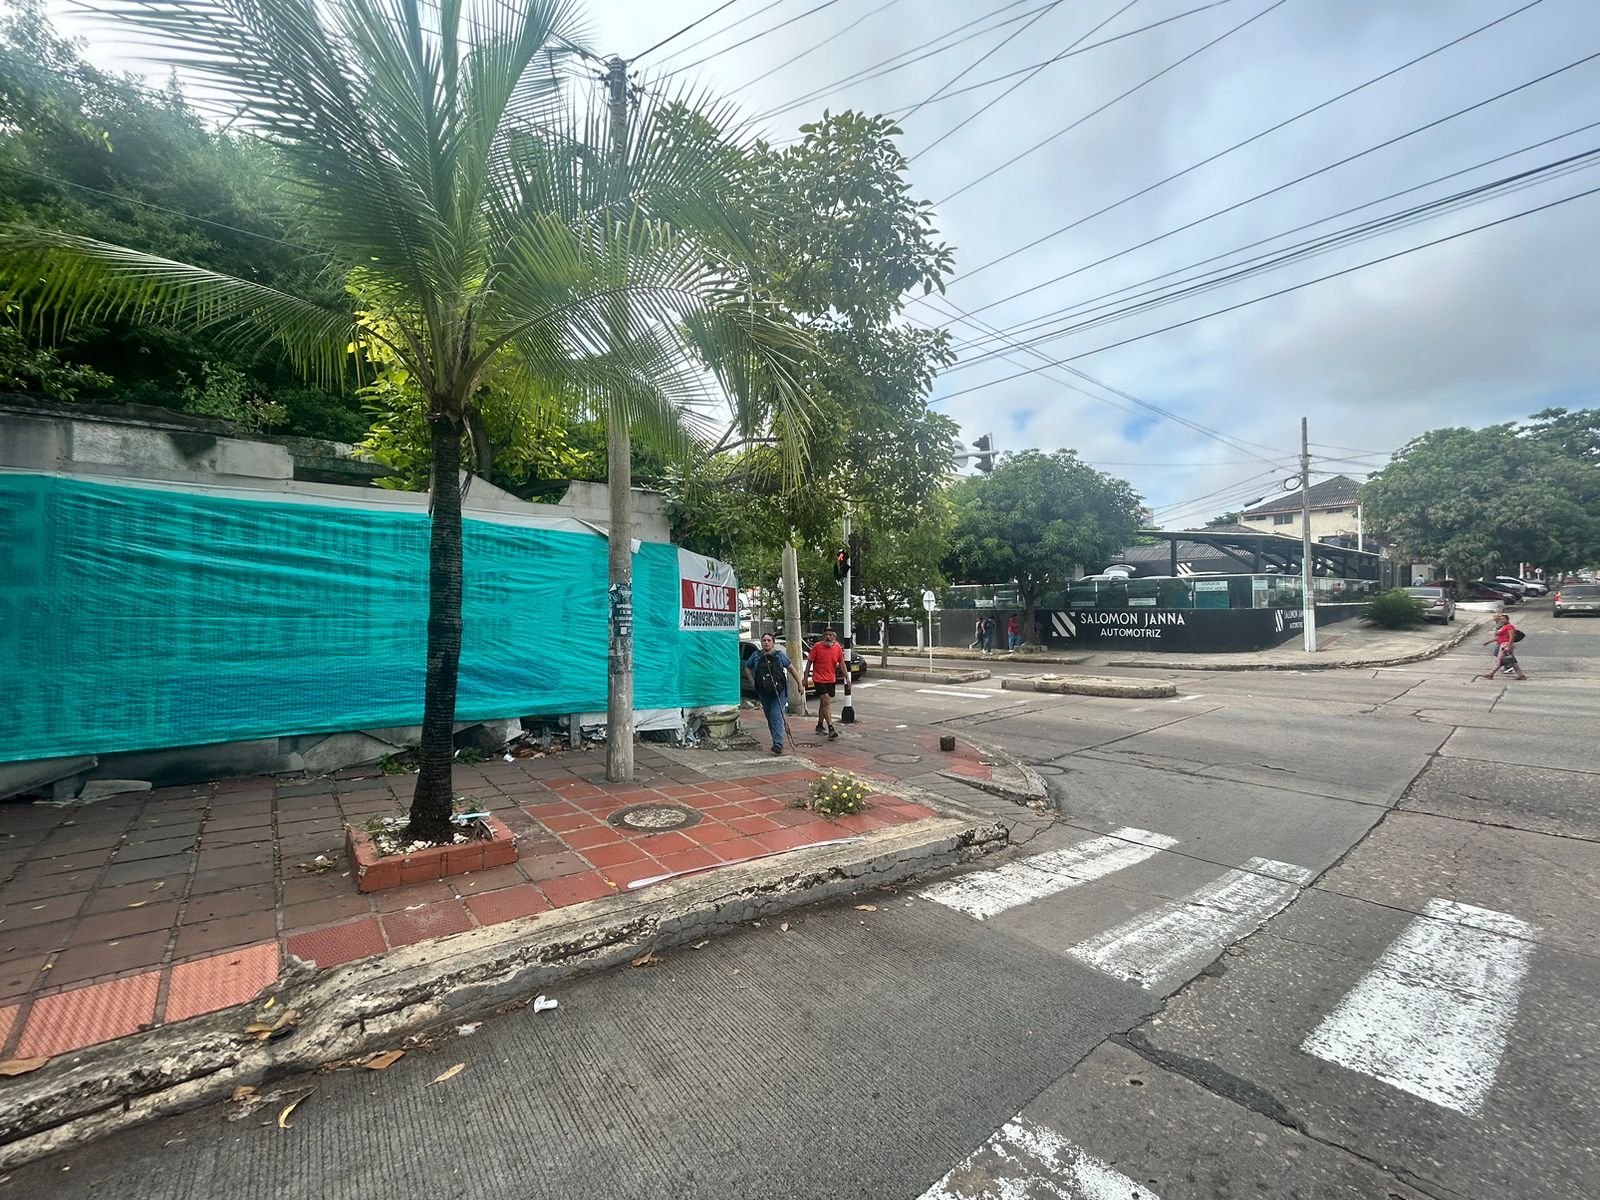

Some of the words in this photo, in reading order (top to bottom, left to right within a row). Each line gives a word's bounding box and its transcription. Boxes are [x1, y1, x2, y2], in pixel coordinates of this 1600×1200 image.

[691, 583, 730, 610] VENDE
[1080, 612, 1138, 625] SALOMON
[1143, 612, 1186, 628] JANNA
[1100, 628, 1162, 638] AUTOMOTRIZ
